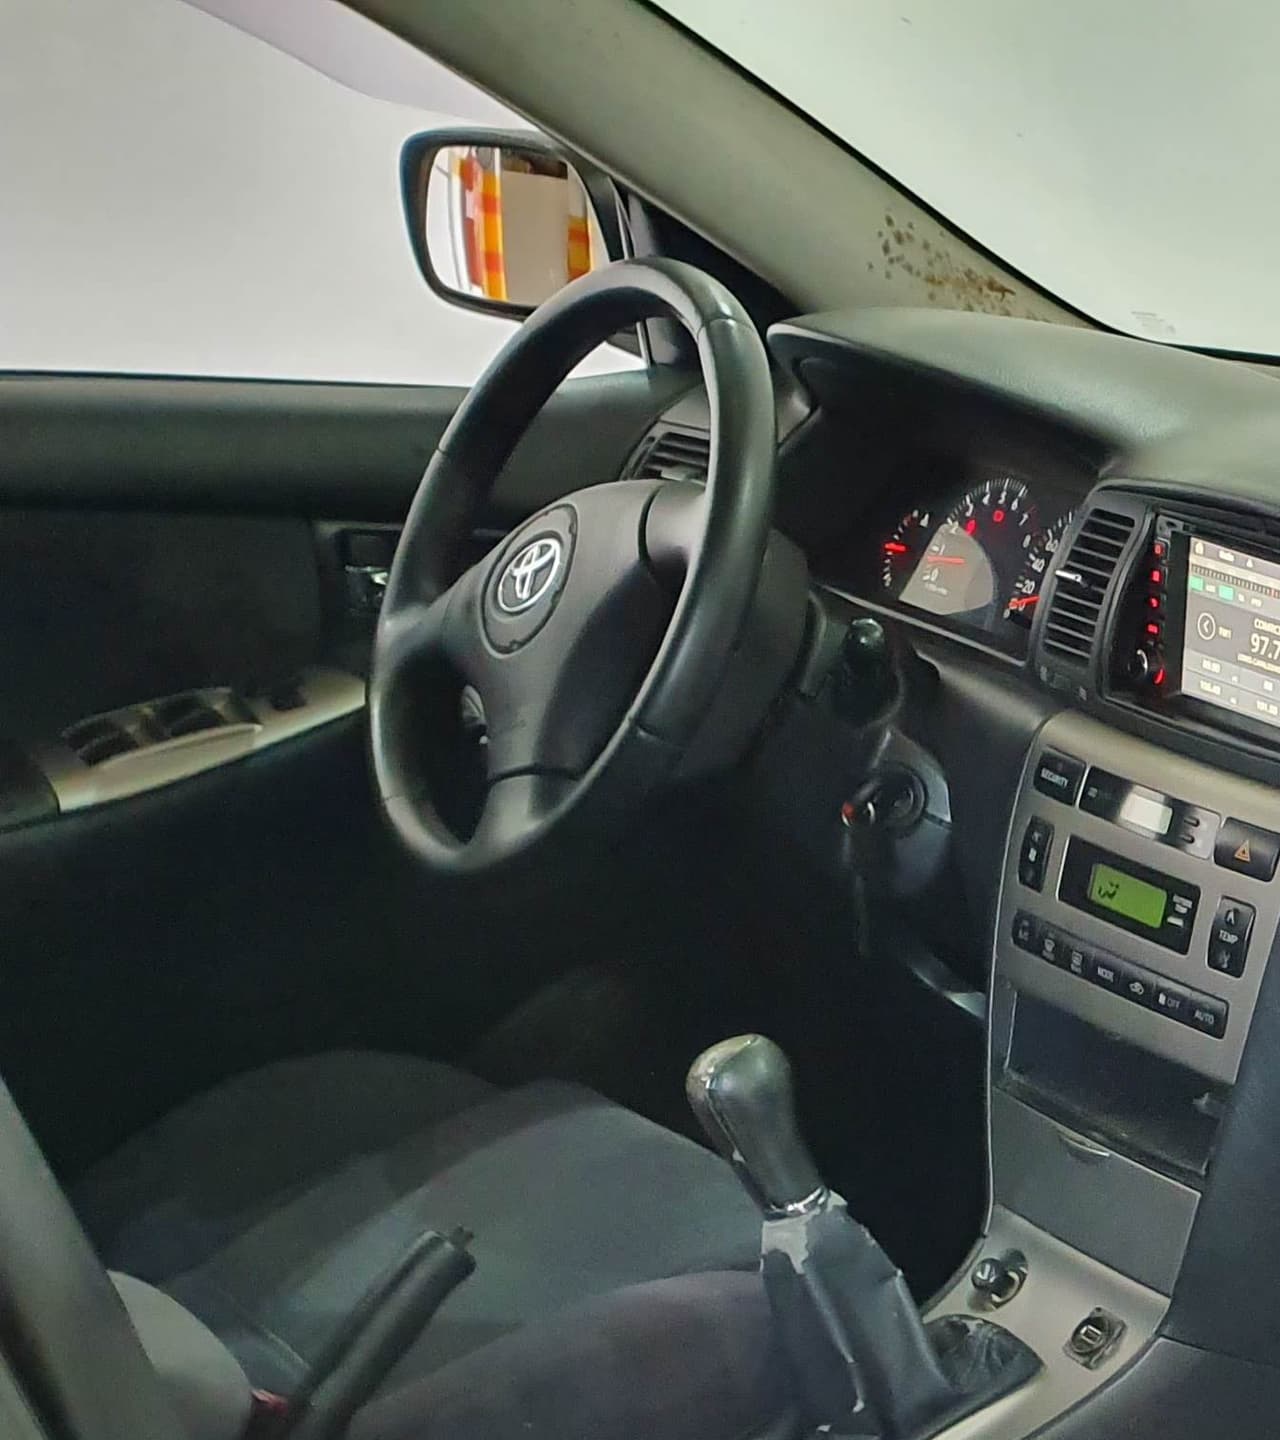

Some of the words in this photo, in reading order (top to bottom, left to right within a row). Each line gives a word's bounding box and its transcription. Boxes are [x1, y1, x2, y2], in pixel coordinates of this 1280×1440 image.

[1022, 580, 1035, 594] 20
[1219, 929, 1239, 945] TEMP
[1194, 1008, 1215, 1026] AUTO
